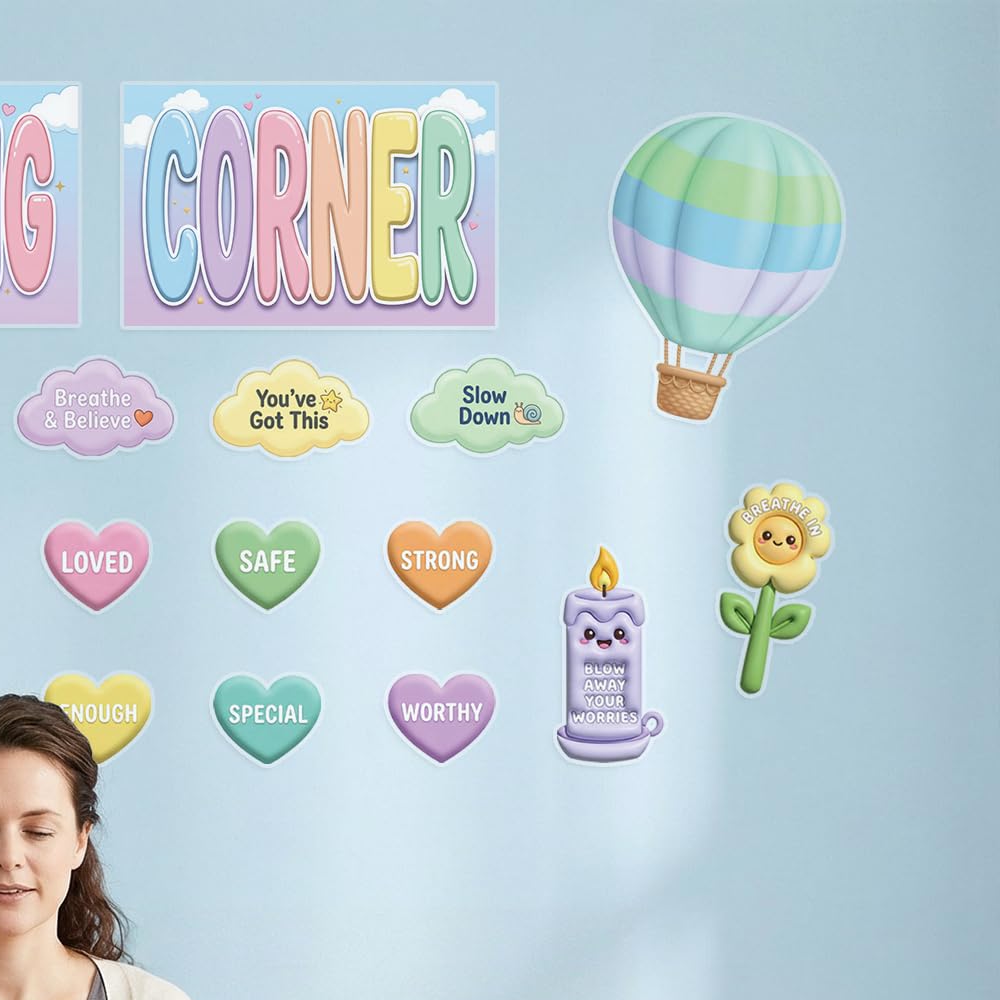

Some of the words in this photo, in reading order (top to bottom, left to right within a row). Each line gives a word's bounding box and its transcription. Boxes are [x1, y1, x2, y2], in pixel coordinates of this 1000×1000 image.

[141, 107, 478, 304] CORNER
[54, 388, 131, 408] Breathe
[256, 389, 317, 409] You've
[462, 385, 507, 406] Slow
[44, 411, 59, 430] &
[63, 410, 131, 431] Believe
[249, 411, 284, 431] Got
[287, 411, 329, 431] This
[459, 407, 511, 427] Down
[741, 498, 809, 524] BREATHE
[808, 518, 823, 537] IN
[61, 550, 133, 574] LOVED
[239, 549, 296, 573] SAFE
[401, 549, 479, 571] STRONG
[584, 663, 625, 676] BLOW
[583, 679, 626, 692] AWAY
[585, 695, 624, 708] YOUR
[229, 703, 308, 725] SPECIAL
[401, 702, 483, 723] WORTHY
[572, 711, 638, 724] WORRIES
